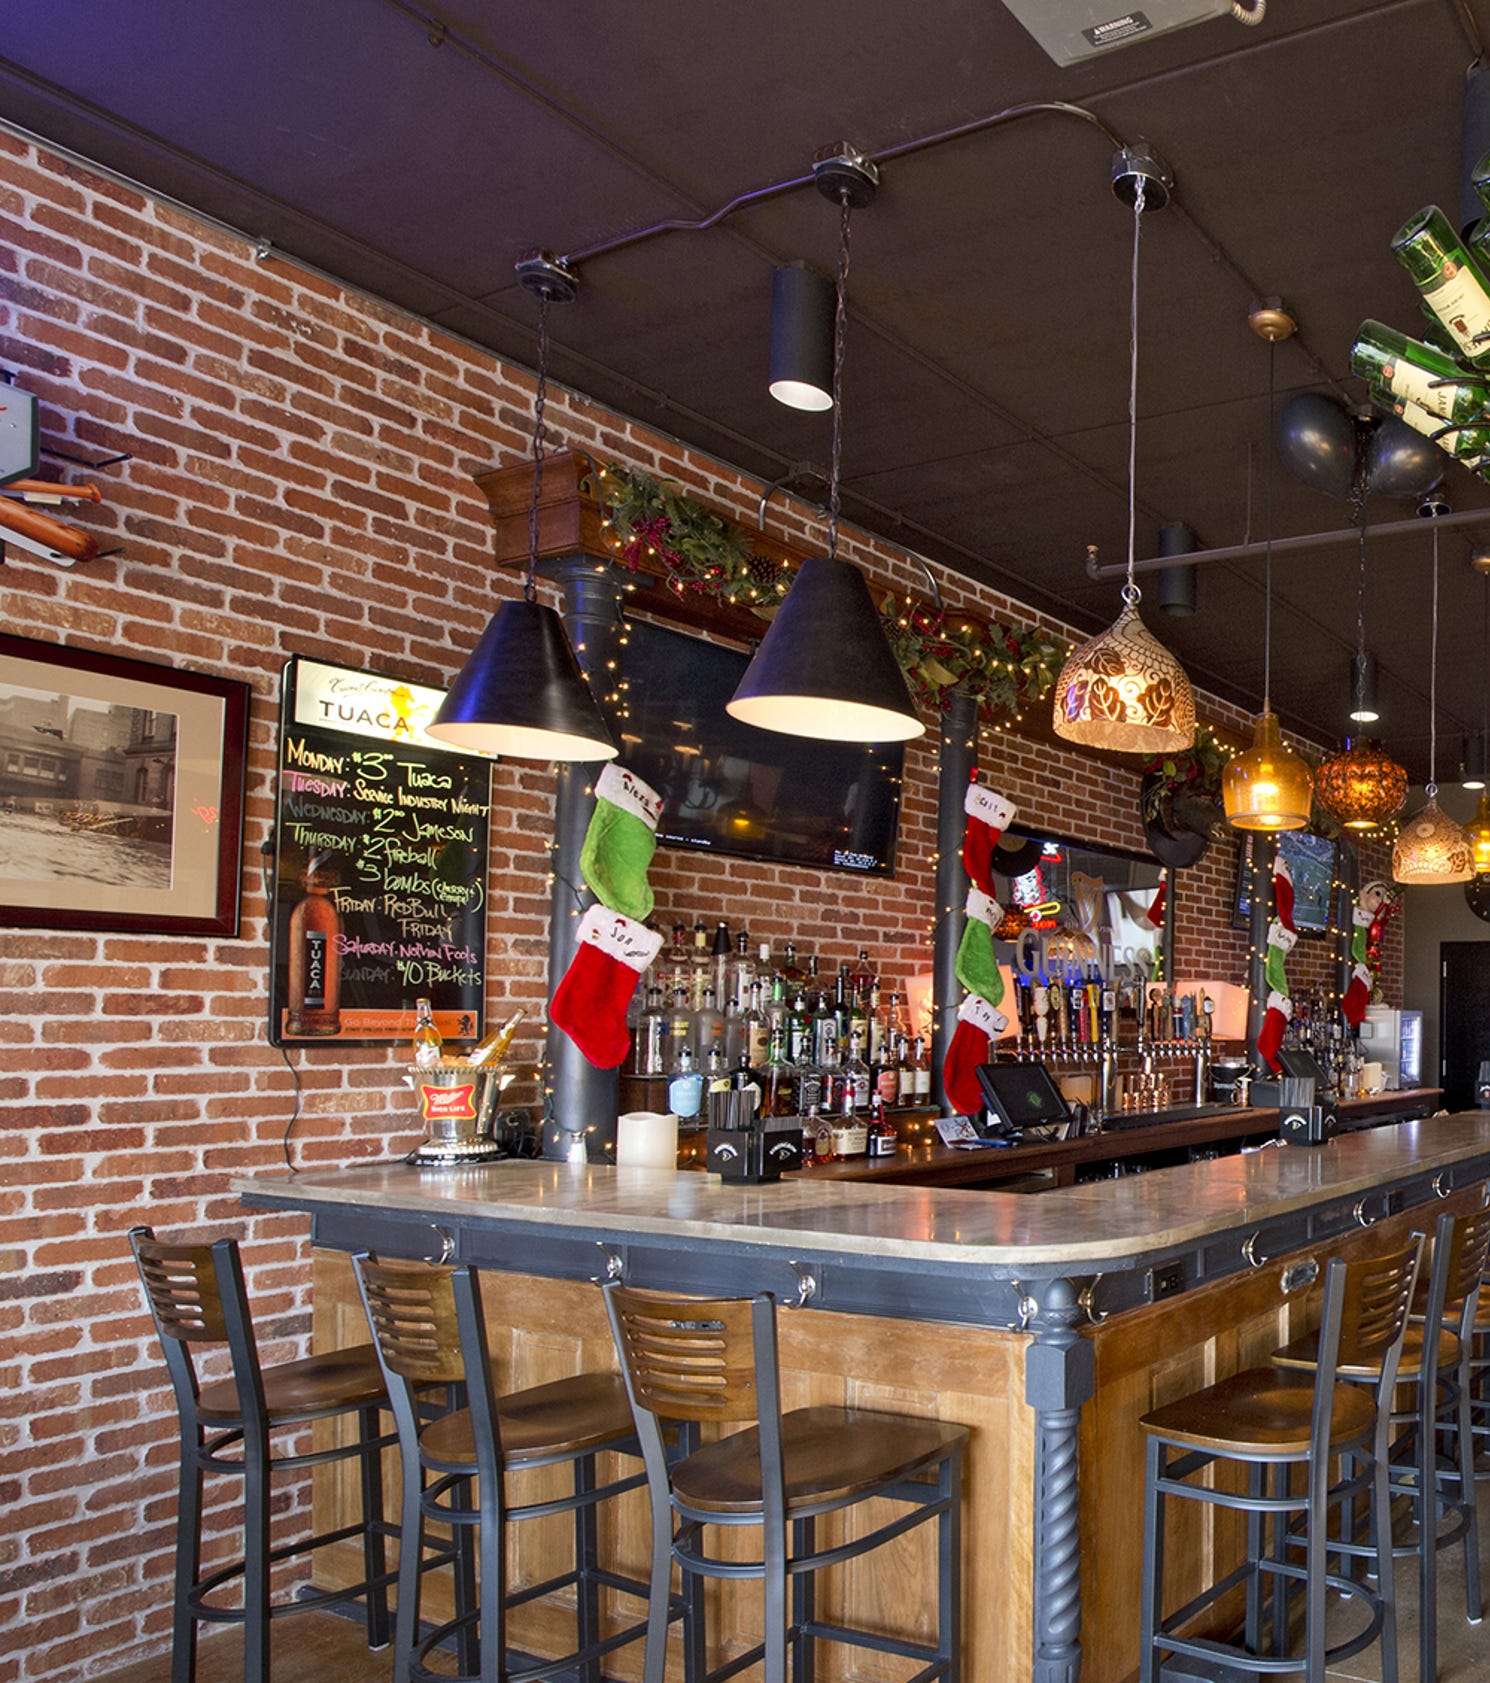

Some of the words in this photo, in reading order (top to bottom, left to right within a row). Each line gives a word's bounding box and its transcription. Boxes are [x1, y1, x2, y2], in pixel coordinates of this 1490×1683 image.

[319, 700, 410, 733] TUACA
[396, 762, 453, 790] Tuaca
[310, 939, 322, 990] TUACA
[1016, 927, 1153, 982] GUINNESS
[430, 1090, 465, 1106] Miller
